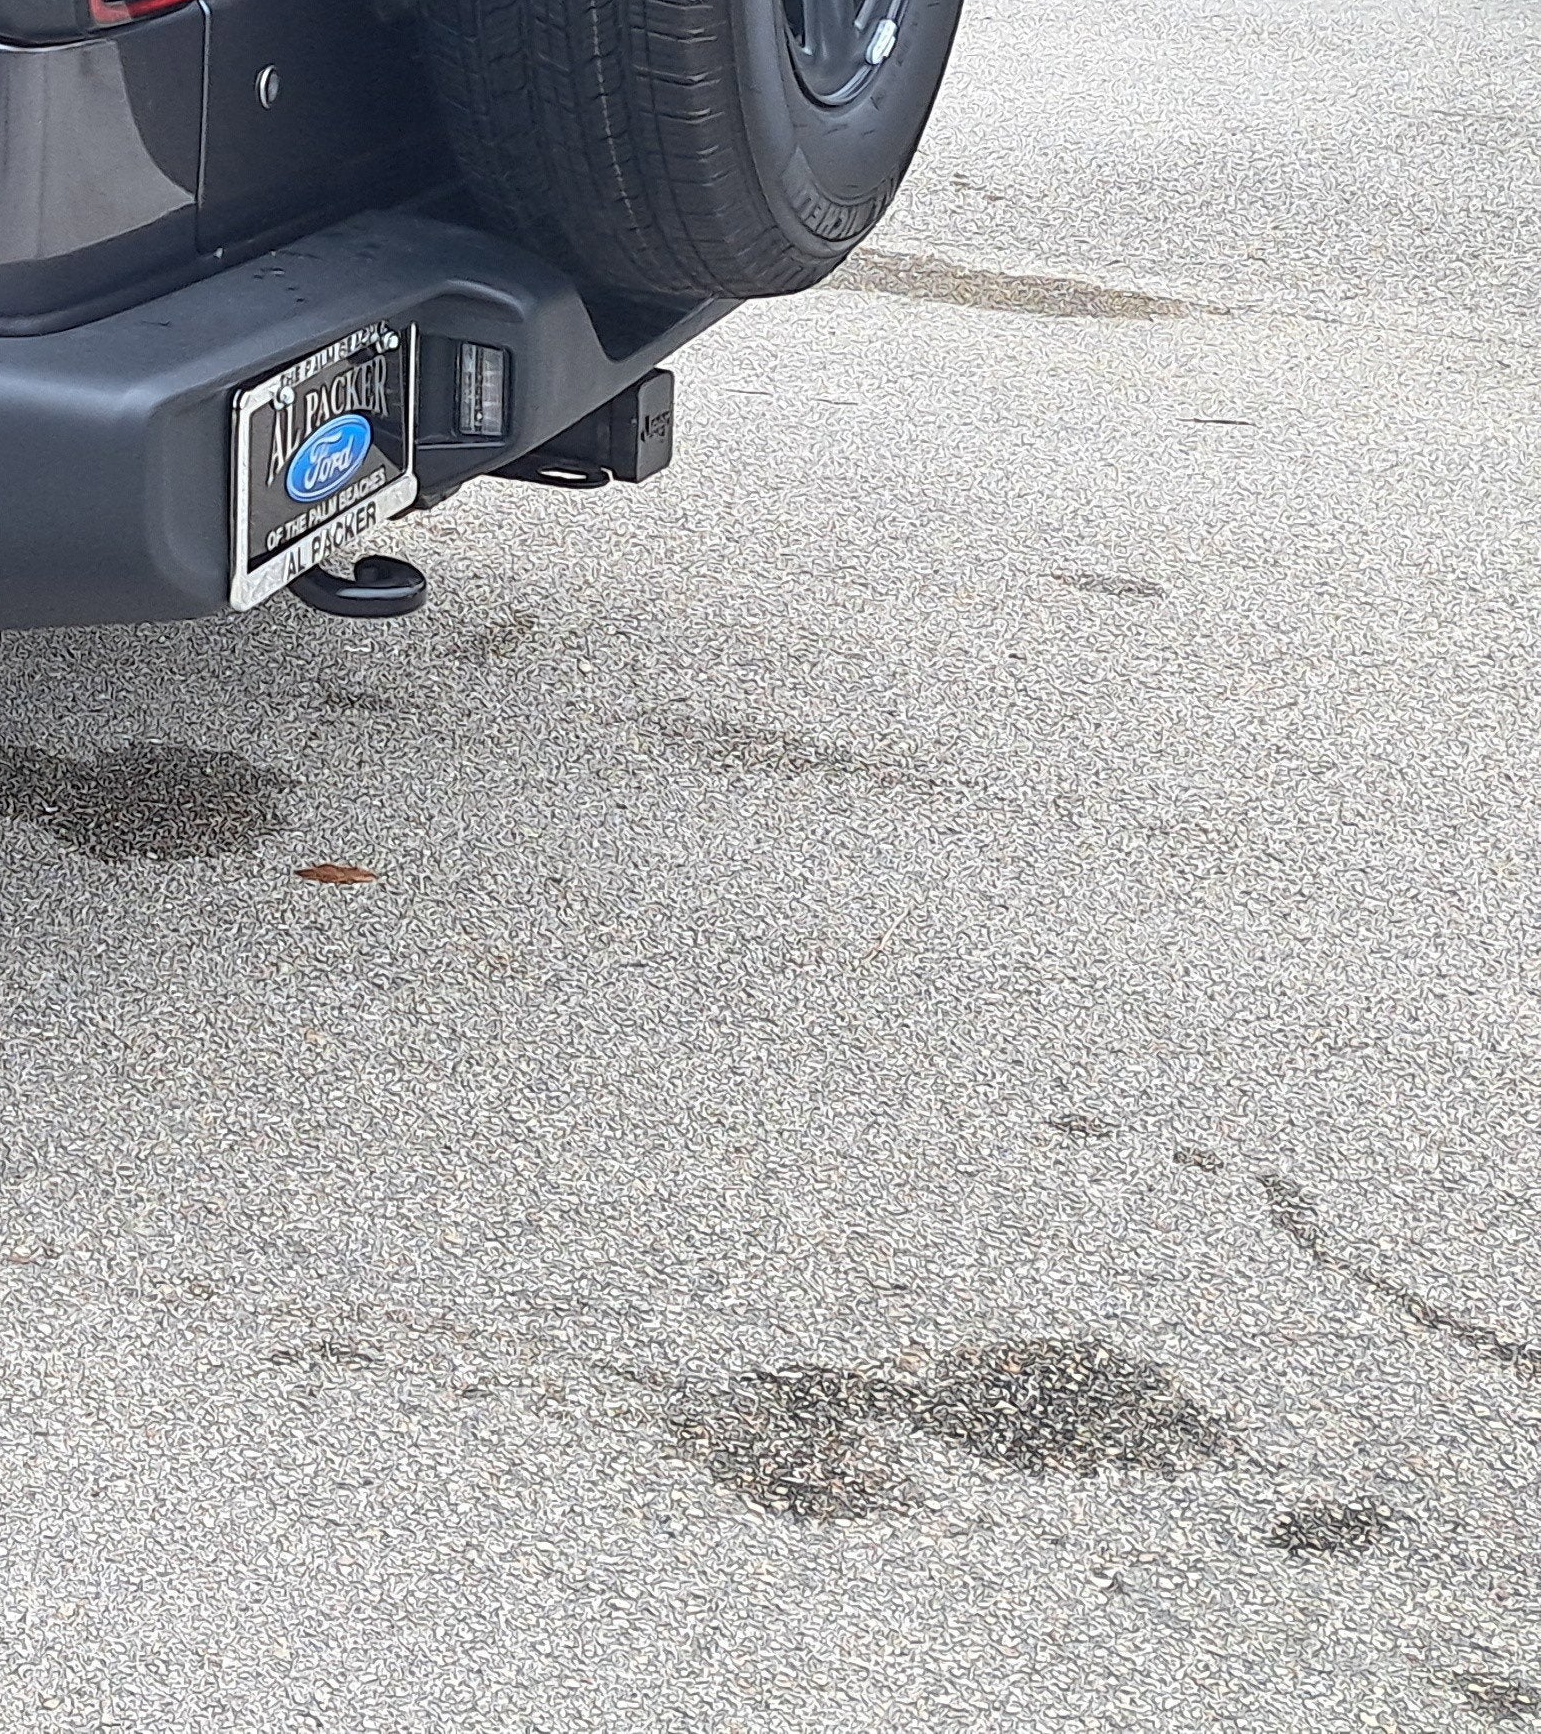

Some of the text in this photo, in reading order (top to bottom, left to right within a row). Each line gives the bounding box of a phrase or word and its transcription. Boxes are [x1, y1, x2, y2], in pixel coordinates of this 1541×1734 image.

[267, 354, 389, 486] AL PACKER
[304, 429, 354, 490] Ford
[267, 527, 284, 552] OF
[285, 513, 307, 539] THE
[286, 501, 377, 576] AL PACKER
